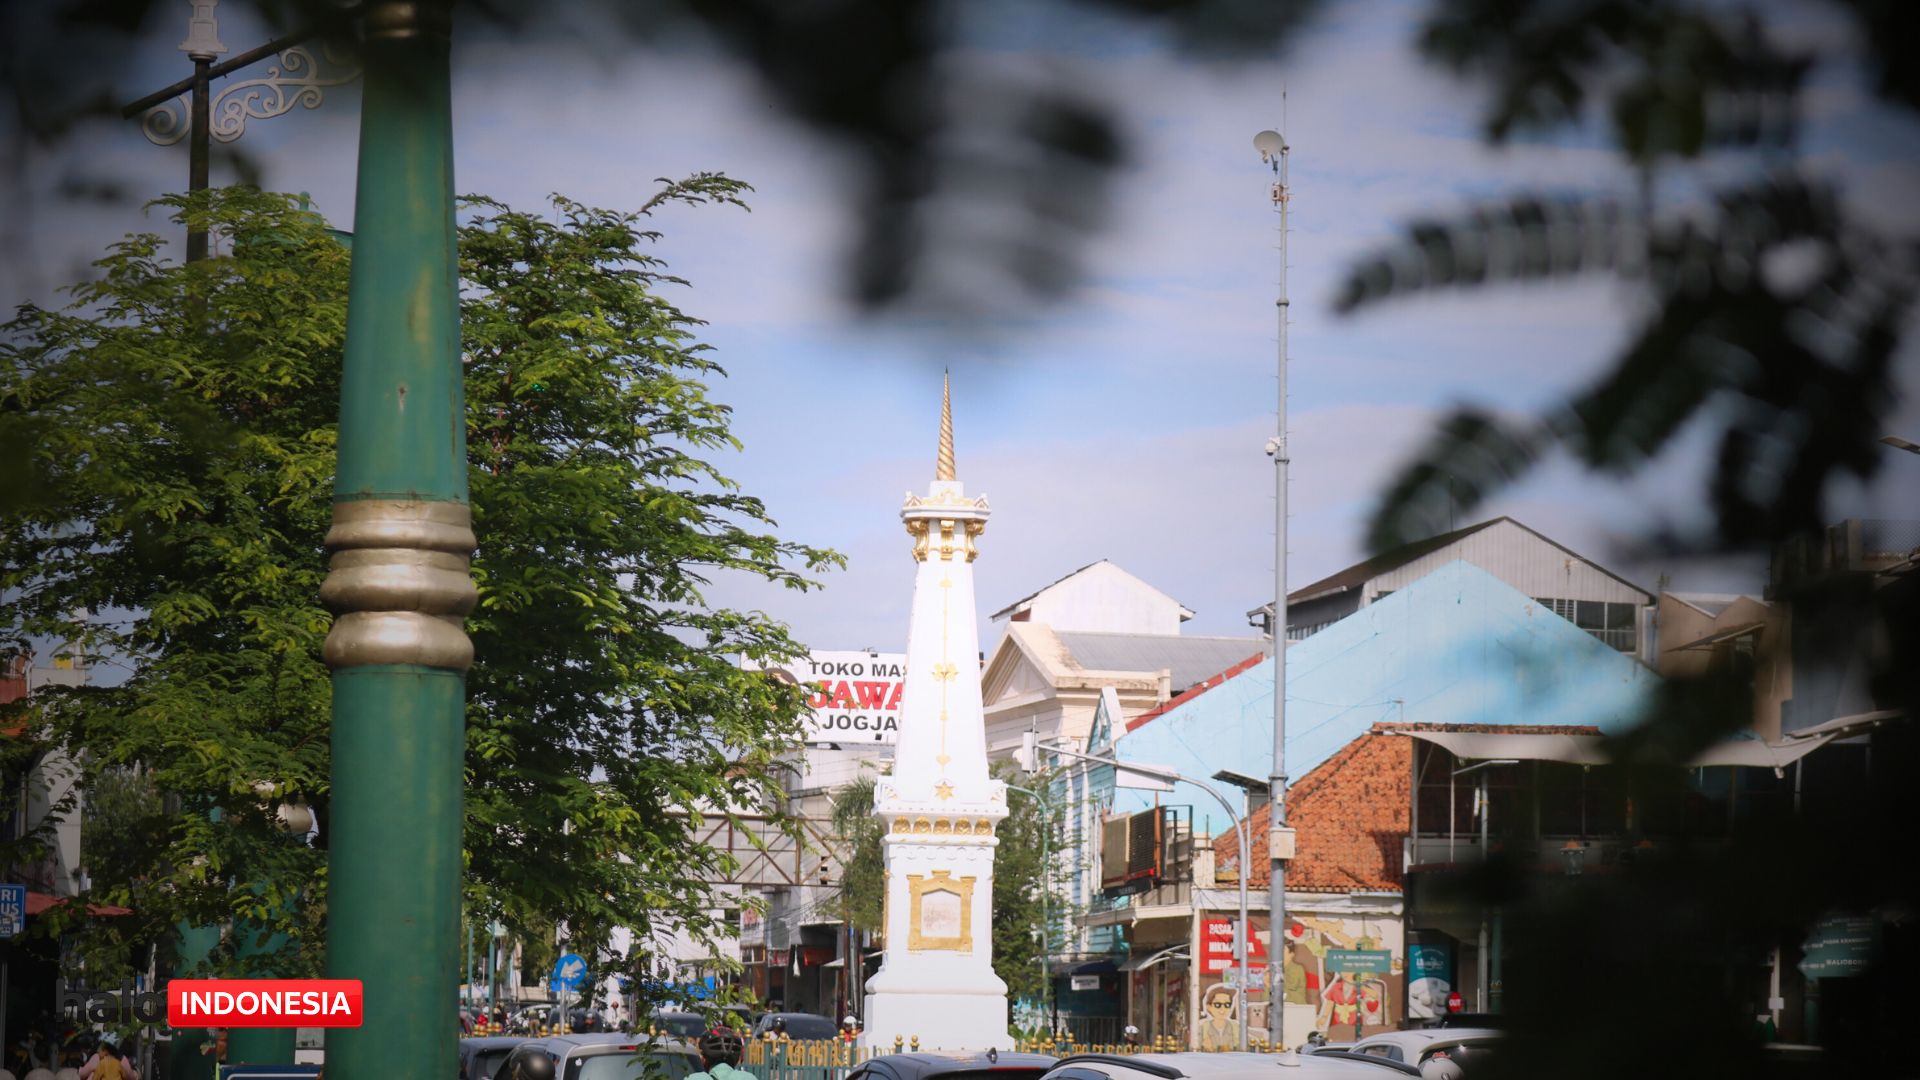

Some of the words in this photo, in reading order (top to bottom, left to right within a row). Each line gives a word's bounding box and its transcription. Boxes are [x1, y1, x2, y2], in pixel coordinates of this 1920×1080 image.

[808, 662, 864, 676] TOKO
[822, 714, 898, 731] JOGJA
[1449, 998, 1461, 1007] OUT
